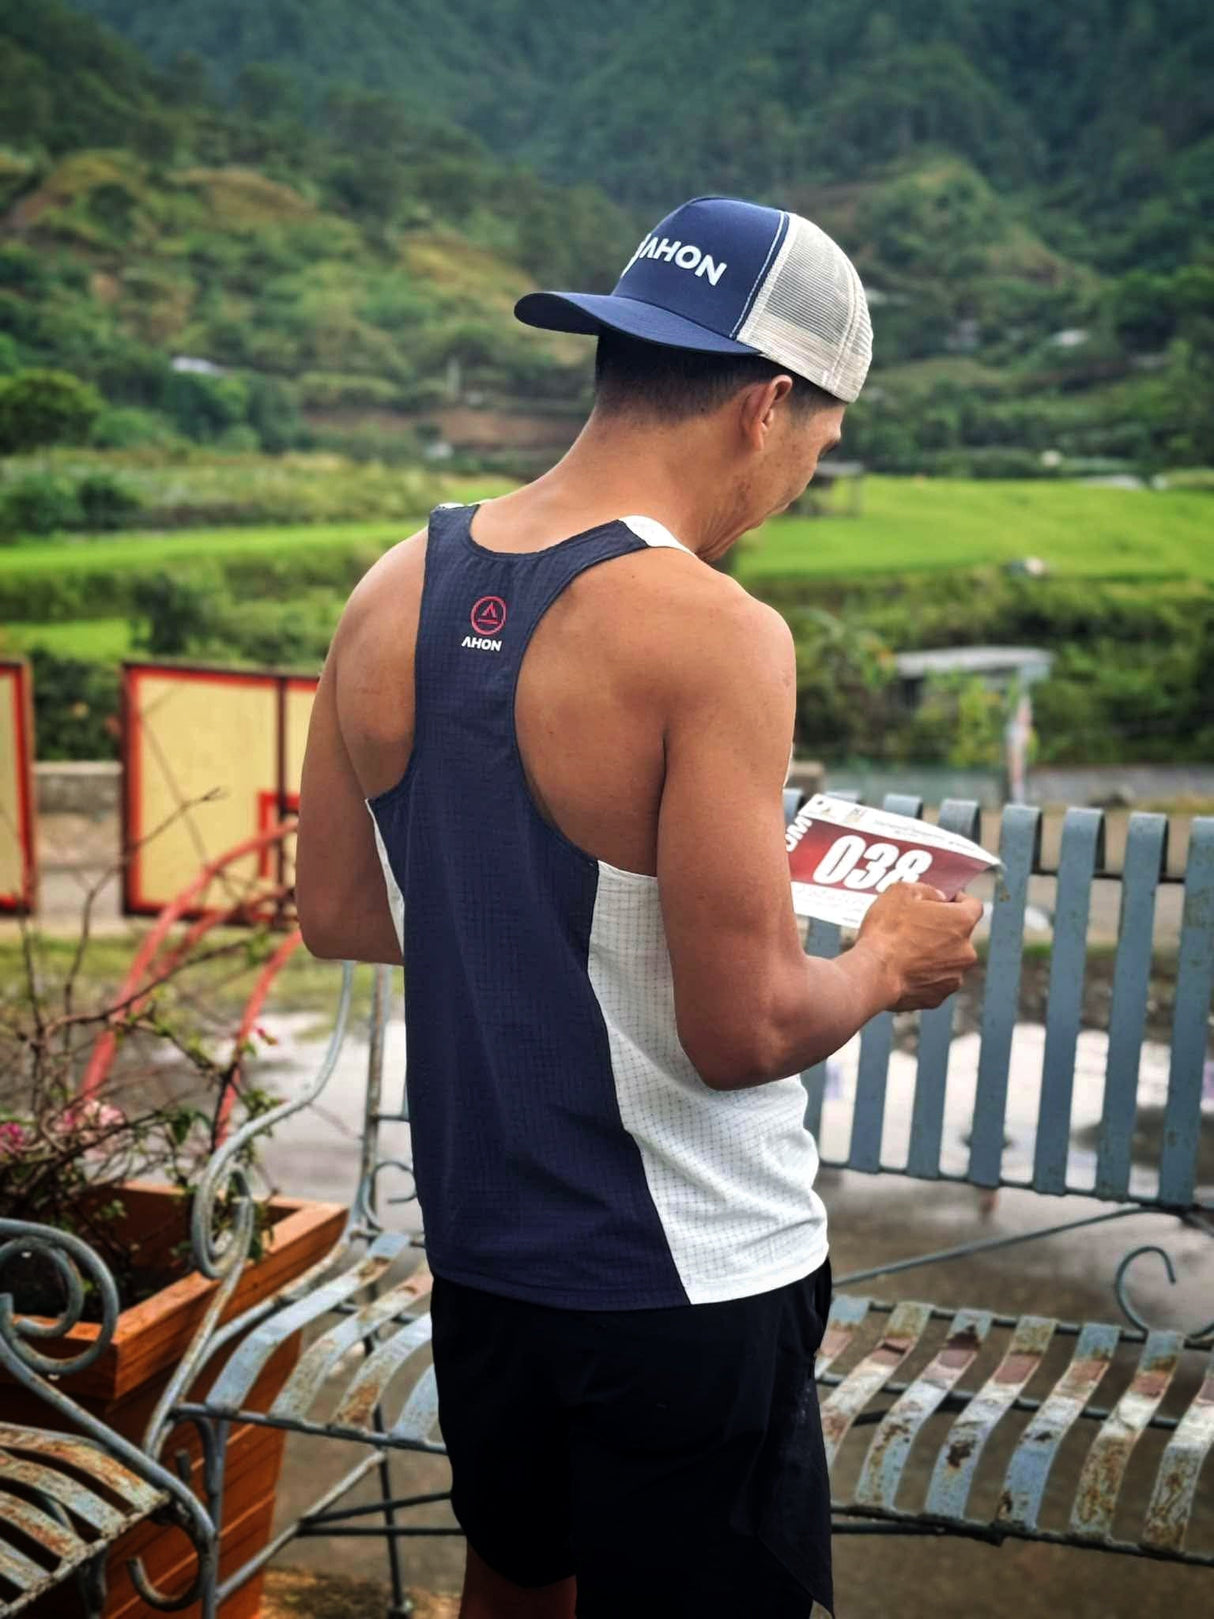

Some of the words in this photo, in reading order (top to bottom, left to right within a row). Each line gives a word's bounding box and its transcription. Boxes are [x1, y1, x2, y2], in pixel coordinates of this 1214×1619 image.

[639, 237, 727, 286] AHON
[461, 636, 502, 652] AHON
[813, 835, 933, 893] 038
